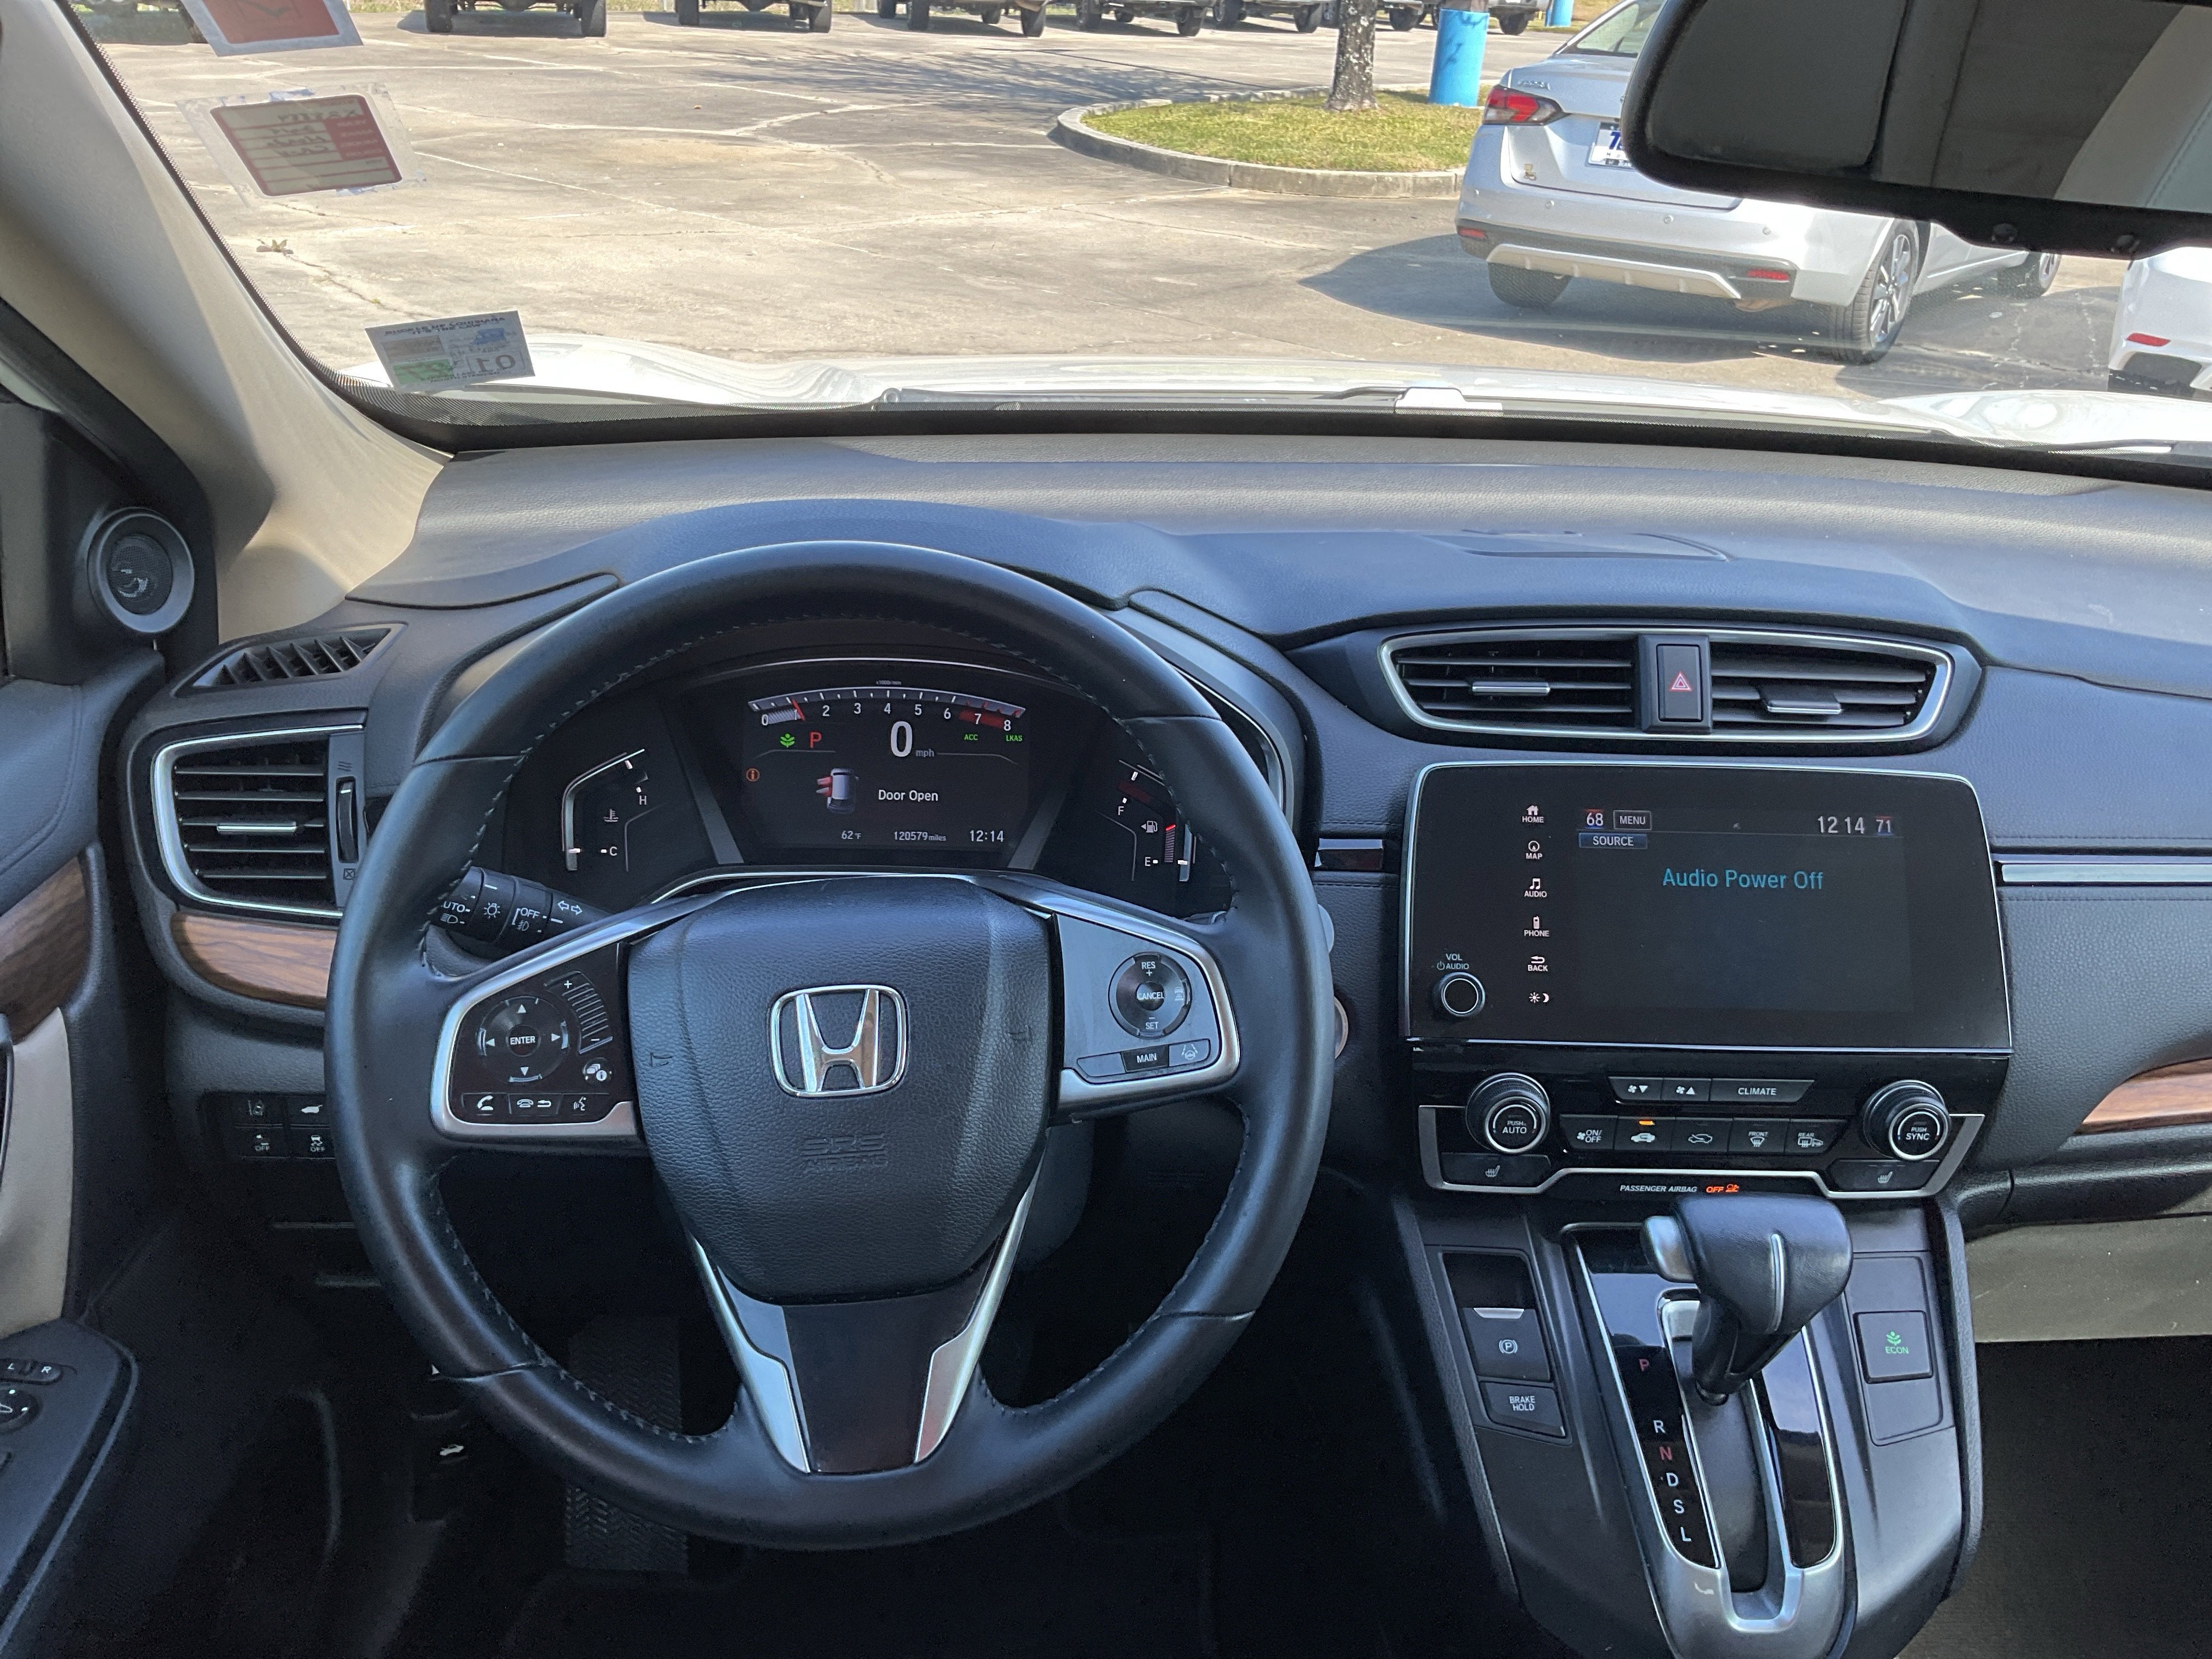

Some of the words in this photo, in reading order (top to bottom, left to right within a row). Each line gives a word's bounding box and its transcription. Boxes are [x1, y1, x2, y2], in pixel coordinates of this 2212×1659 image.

[761, 714, 769, 726] 0
[822, 705, 830, 716] 2
[854, 702, 861, 714] 3
[884, 703, 891, 714] 4
[915, 704, 922, 715] 5
[944, 708, 951, 719] 6
[974, 713, 981, 725] 7
[1003, 719, 1011, 731] 8
[809, 731, 822, 748] P
[890, 721, 913, 757] 0
[916, 749, 934, 758] mph
[639, 795, 647, 805] H
[878, 789, 905, 800] Door
[909, 790, 939, 802] Open
[1118, 806, 1124, 816] F
[1586, 812, 1604, 826] 68
[1619, 815, 1646, 825] MENU
[1876, 819, 1892, 833] 71
[969, 830, 1005, 843] 12:14
[1593, 836, 1634, 847] SOURCE
[610, 846, 618, 856] C
[1144, 856, 1151, 866] E
[1662, 868, 1718, 888] Audio
[1725, 869, 1786, 889] Power
[1793, 871, 1824, 890] Off
[520, 907, 540, 919] OFF
[1446, 953, 1463, 961] VOL
[1141, 961, 1156, 970] RES
[1446, 962, 1469, 970] AUDIO
[1527, 964, 1548, 972] BACK
[1137, 991, 1164, 1001] CANCEL
[1145, 1021, 1159, 1030] SET
[510, 1035, 535, 1045] ENTER
[1137, 1053, 1157, 1063] MAIN
[1737, 1087, 1777, 1096] CLIMATE
[1502, 1126, 1527, 1135] AUTO
[1905, 1133, 1930, 1141] SYNC
[1620, 1184, 1666, 1193] PASSENGER
[1639, 1358, 1650, 1371] P
[1509, 1395, 1536, 1404] BRAKE
[1513, 1403, 1534, 1412] HOLD
[1654, 1419, 1666, 1434] R
[1659, 1446, 1673, 1460] N
[1666, 1472, 1679, 1487] D
[1673, 1499, 1685, 1514] S
[1680, 1526, 1691, 1542] L
